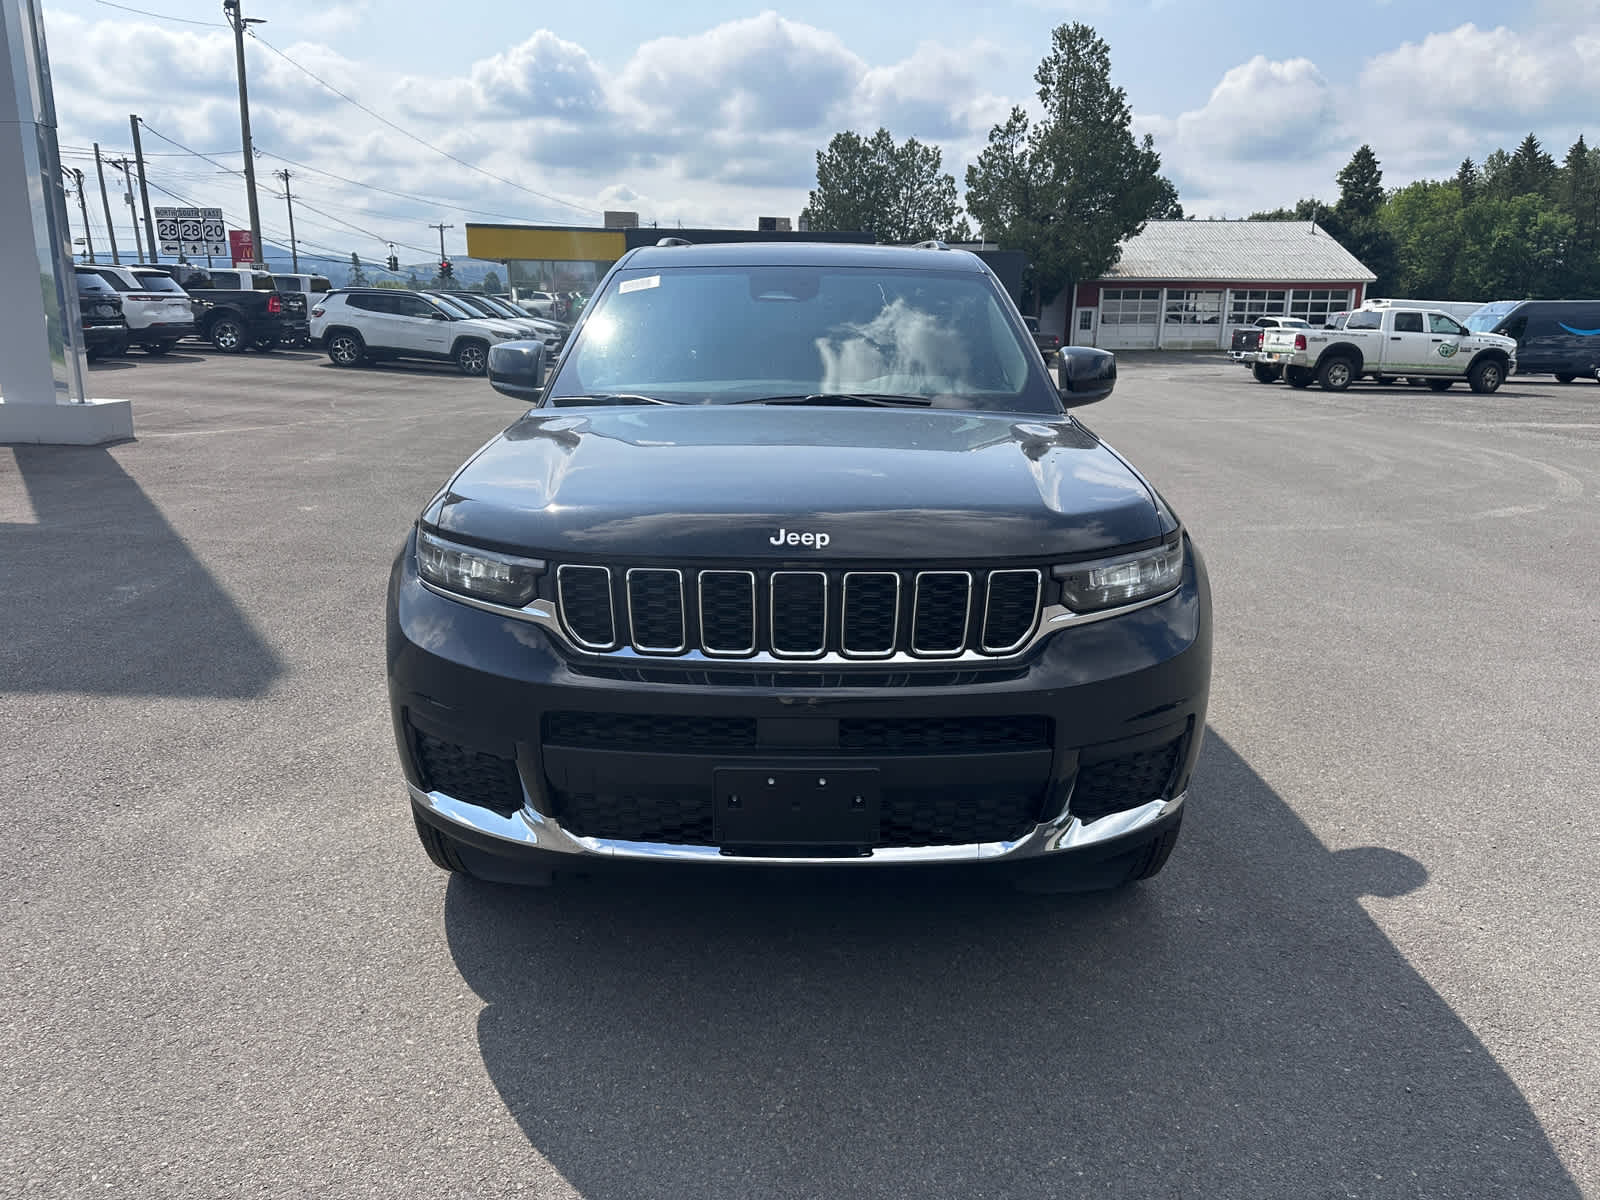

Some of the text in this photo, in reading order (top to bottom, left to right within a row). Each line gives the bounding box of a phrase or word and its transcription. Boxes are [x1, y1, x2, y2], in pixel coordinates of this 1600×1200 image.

[178, 209, 199, 217] SOUTH
[204, 209, 220, 217] EAST
[160, 223, 177, 237] 28
[182, 223, 200, 237] 28
[205, 224, 223, 237] 20
[769, 528, 830, 549] Jeep
